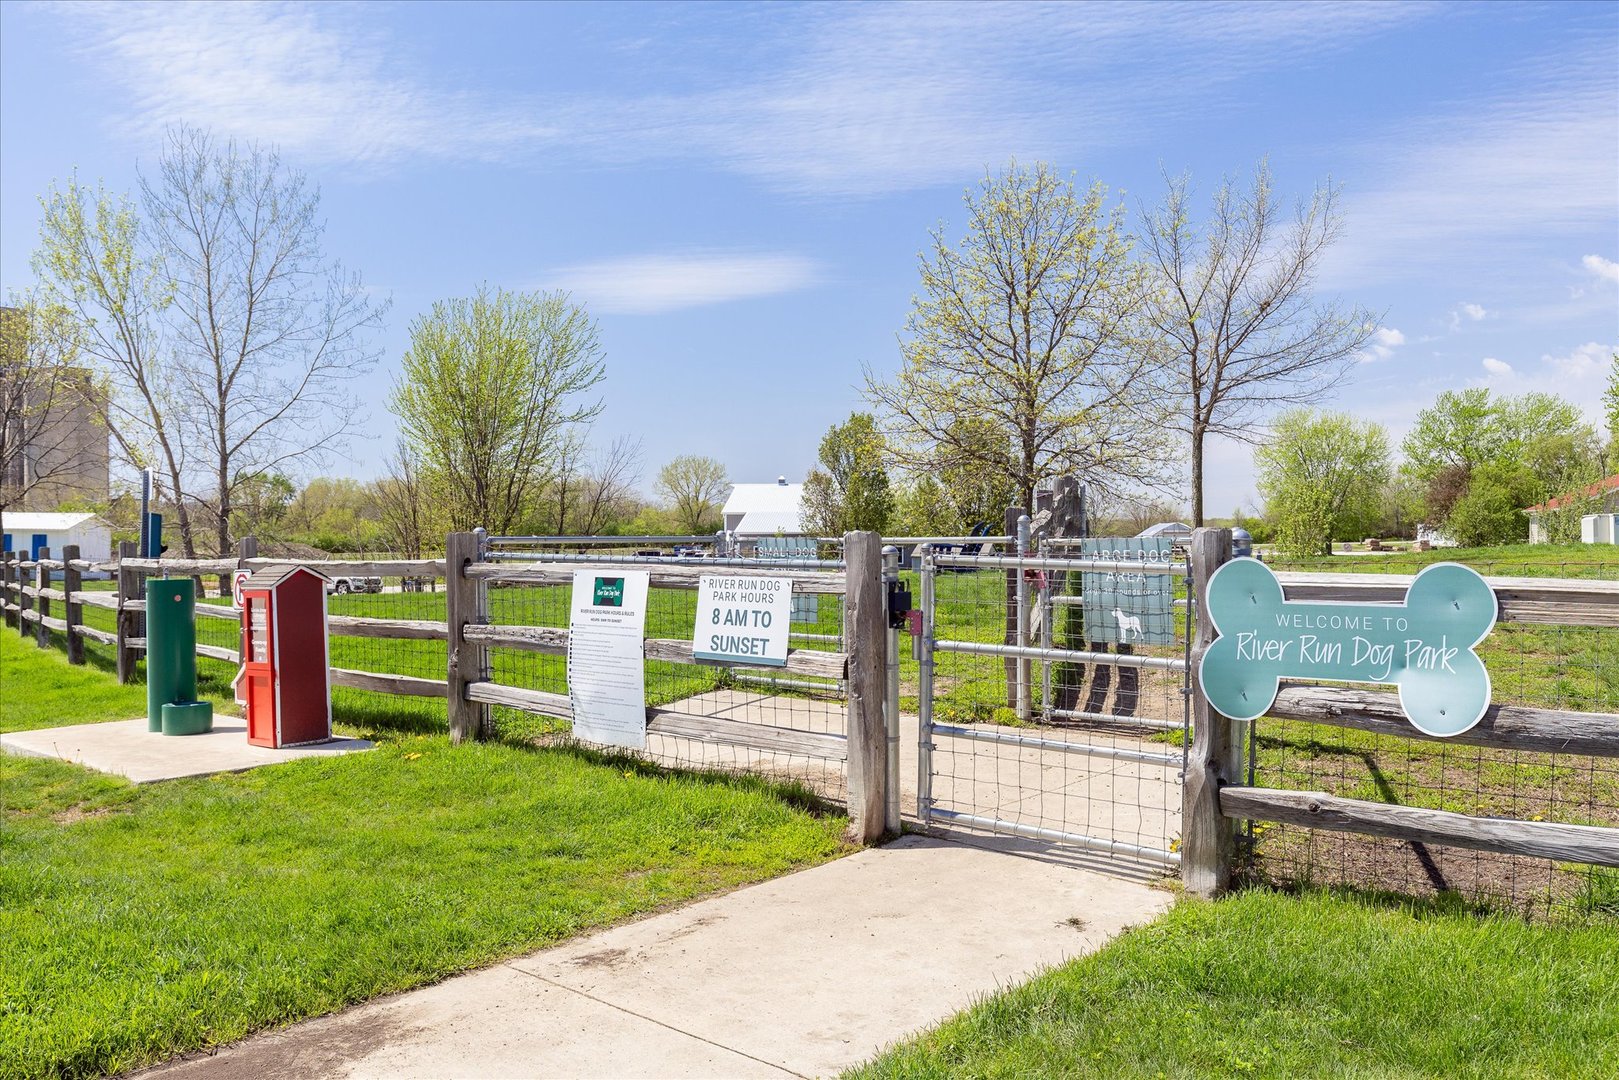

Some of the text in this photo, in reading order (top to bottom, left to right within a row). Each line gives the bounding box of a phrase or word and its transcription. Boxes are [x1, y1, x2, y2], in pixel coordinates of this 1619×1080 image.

[758, 546, 817, 558] SMALL DOG
[1137, 549, 1170, 563] DOG
[1105, 571, 1146, 583] AREA
[708, 578, 781, 592] RIVER RUN DOG
[712, 591, 774, 604] PARK HOURS
[712, 608, 772, 628] 8 AM TO
[1275, 613, 1408, 632] WELCOME TO
[710, 634, 770, 656] SUNSET
[1236, 629, 1458, 681] River Run Dog Park
